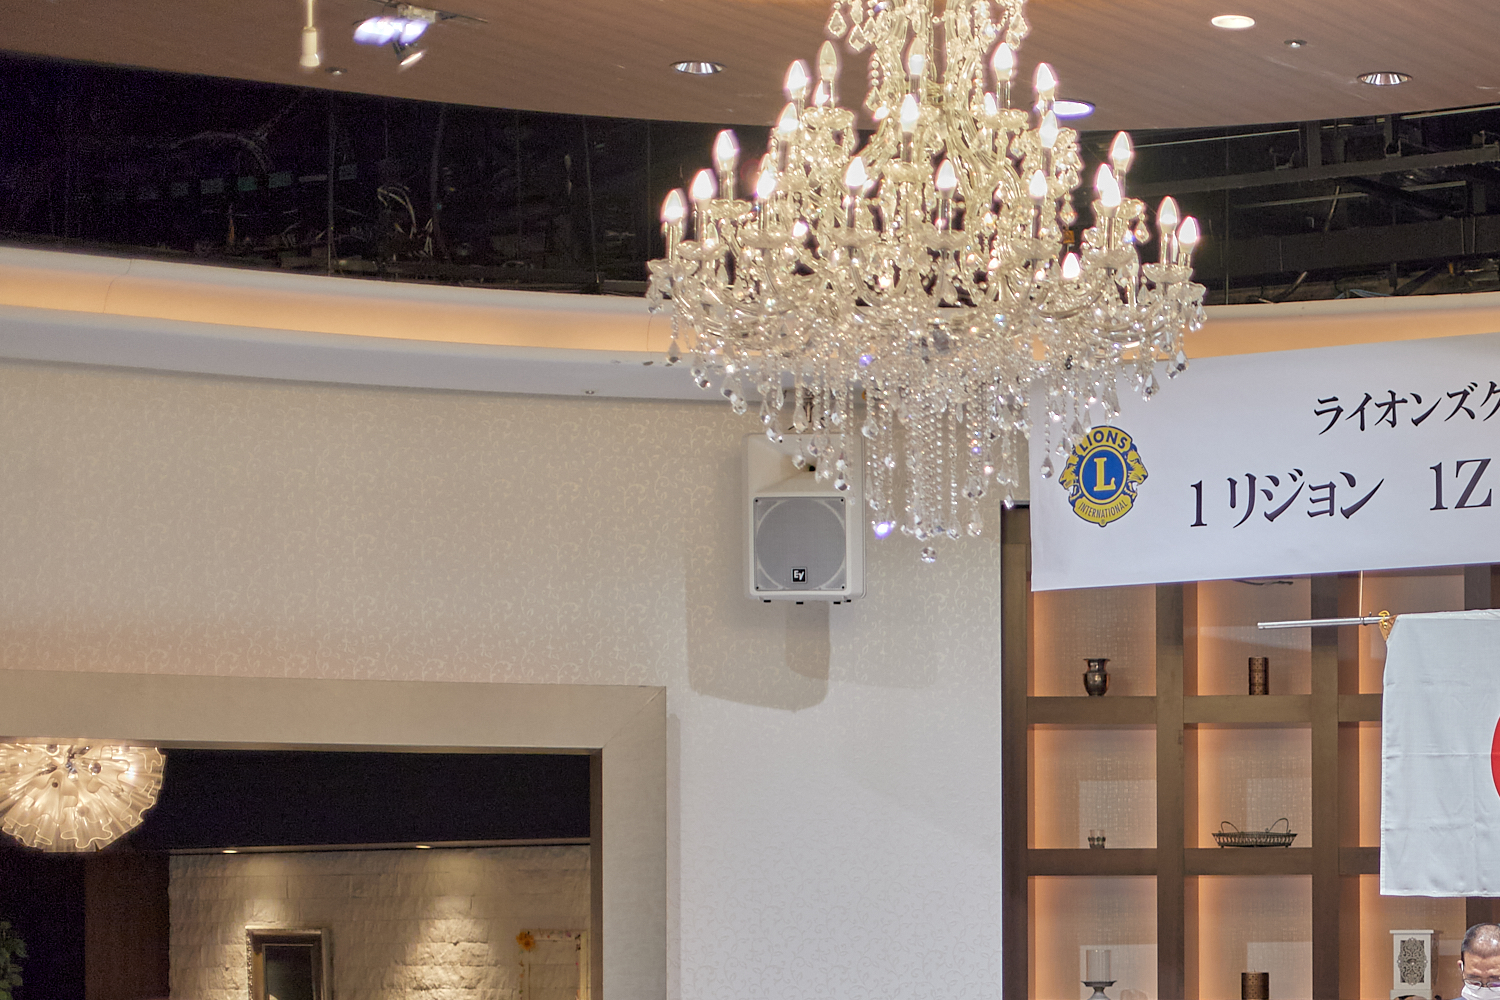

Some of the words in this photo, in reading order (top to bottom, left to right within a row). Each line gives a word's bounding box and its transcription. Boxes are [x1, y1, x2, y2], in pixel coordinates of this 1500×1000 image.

[1078, 430, 1128, 452] LIONS
[1093, 457, 1117, 492] L
[1078, 500, 1128, 519] INTERNATIONAL
